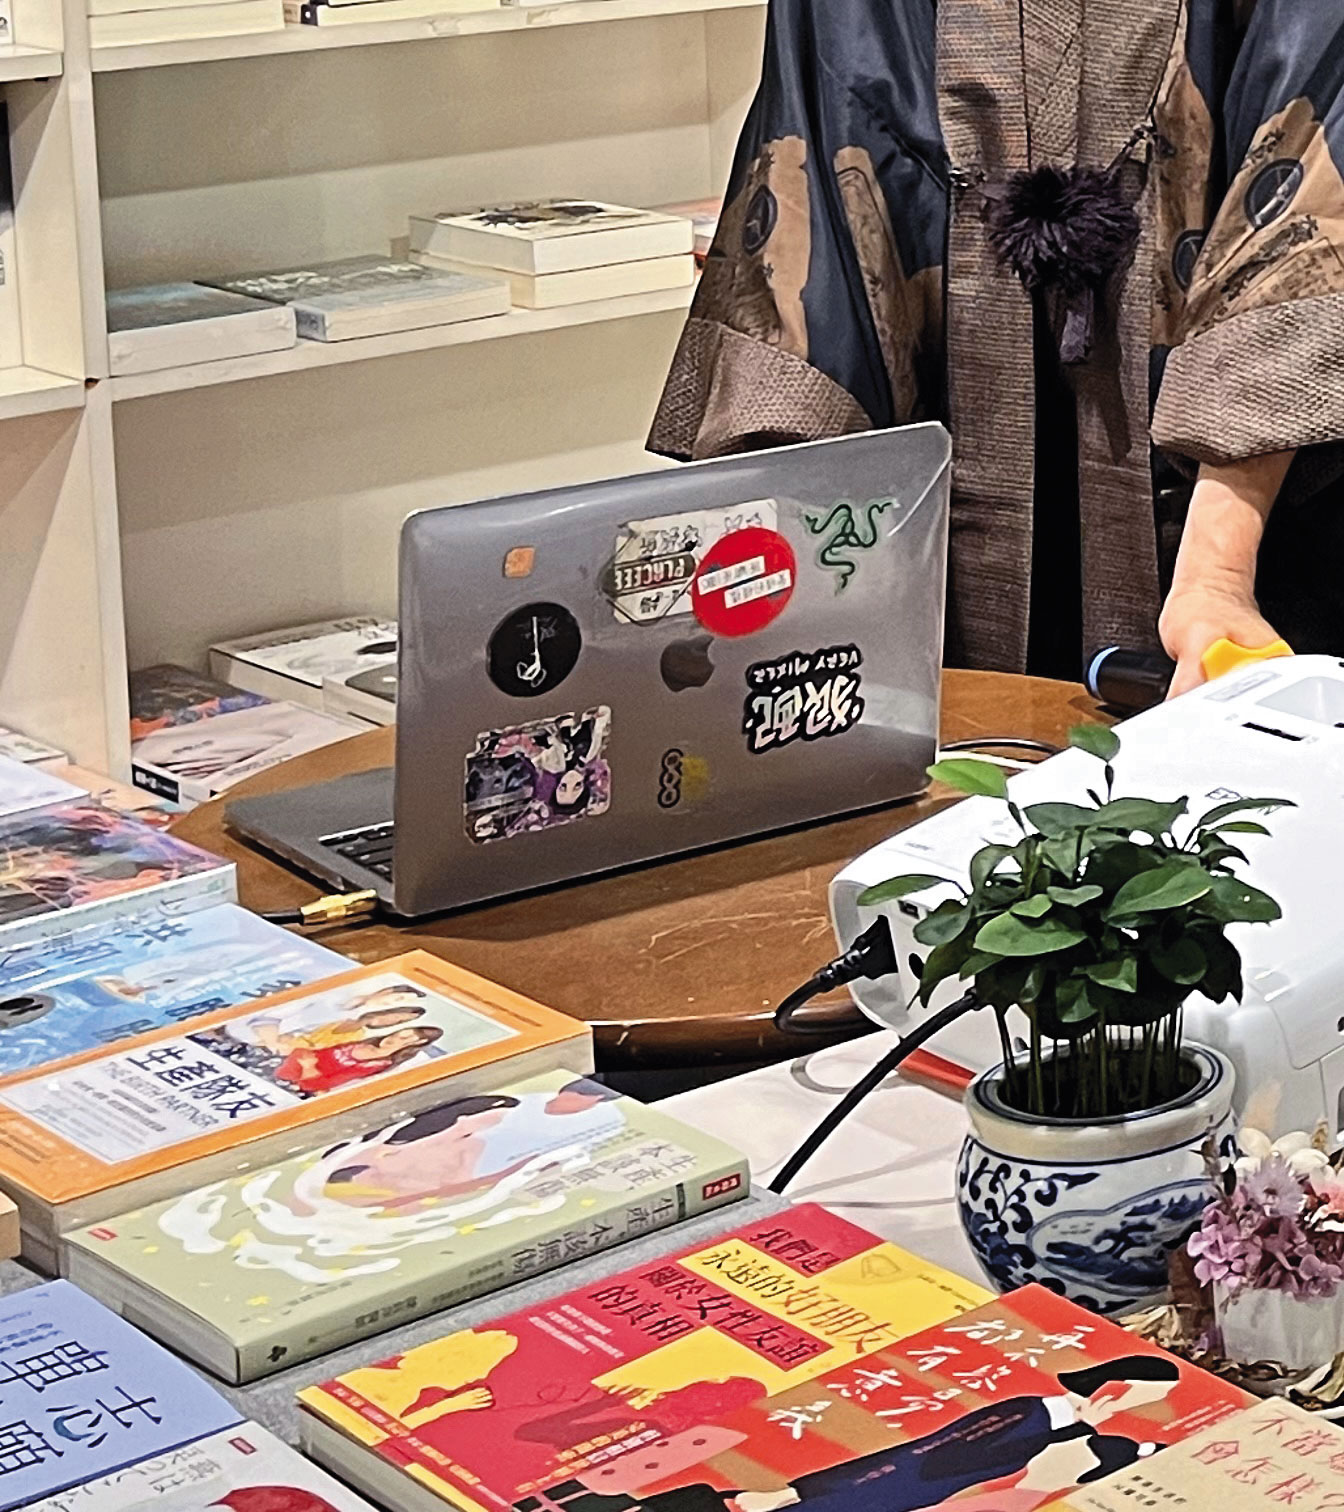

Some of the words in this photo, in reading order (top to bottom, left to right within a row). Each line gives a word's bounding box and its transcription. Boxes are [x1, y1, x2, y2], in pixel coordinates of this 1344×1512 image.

[589, 1285, 695, 1343] 的真相
[639, 1264, 821, 1365] 關於女性友誼
[700, 1246, 892, 1355] 永遠的好朋友
